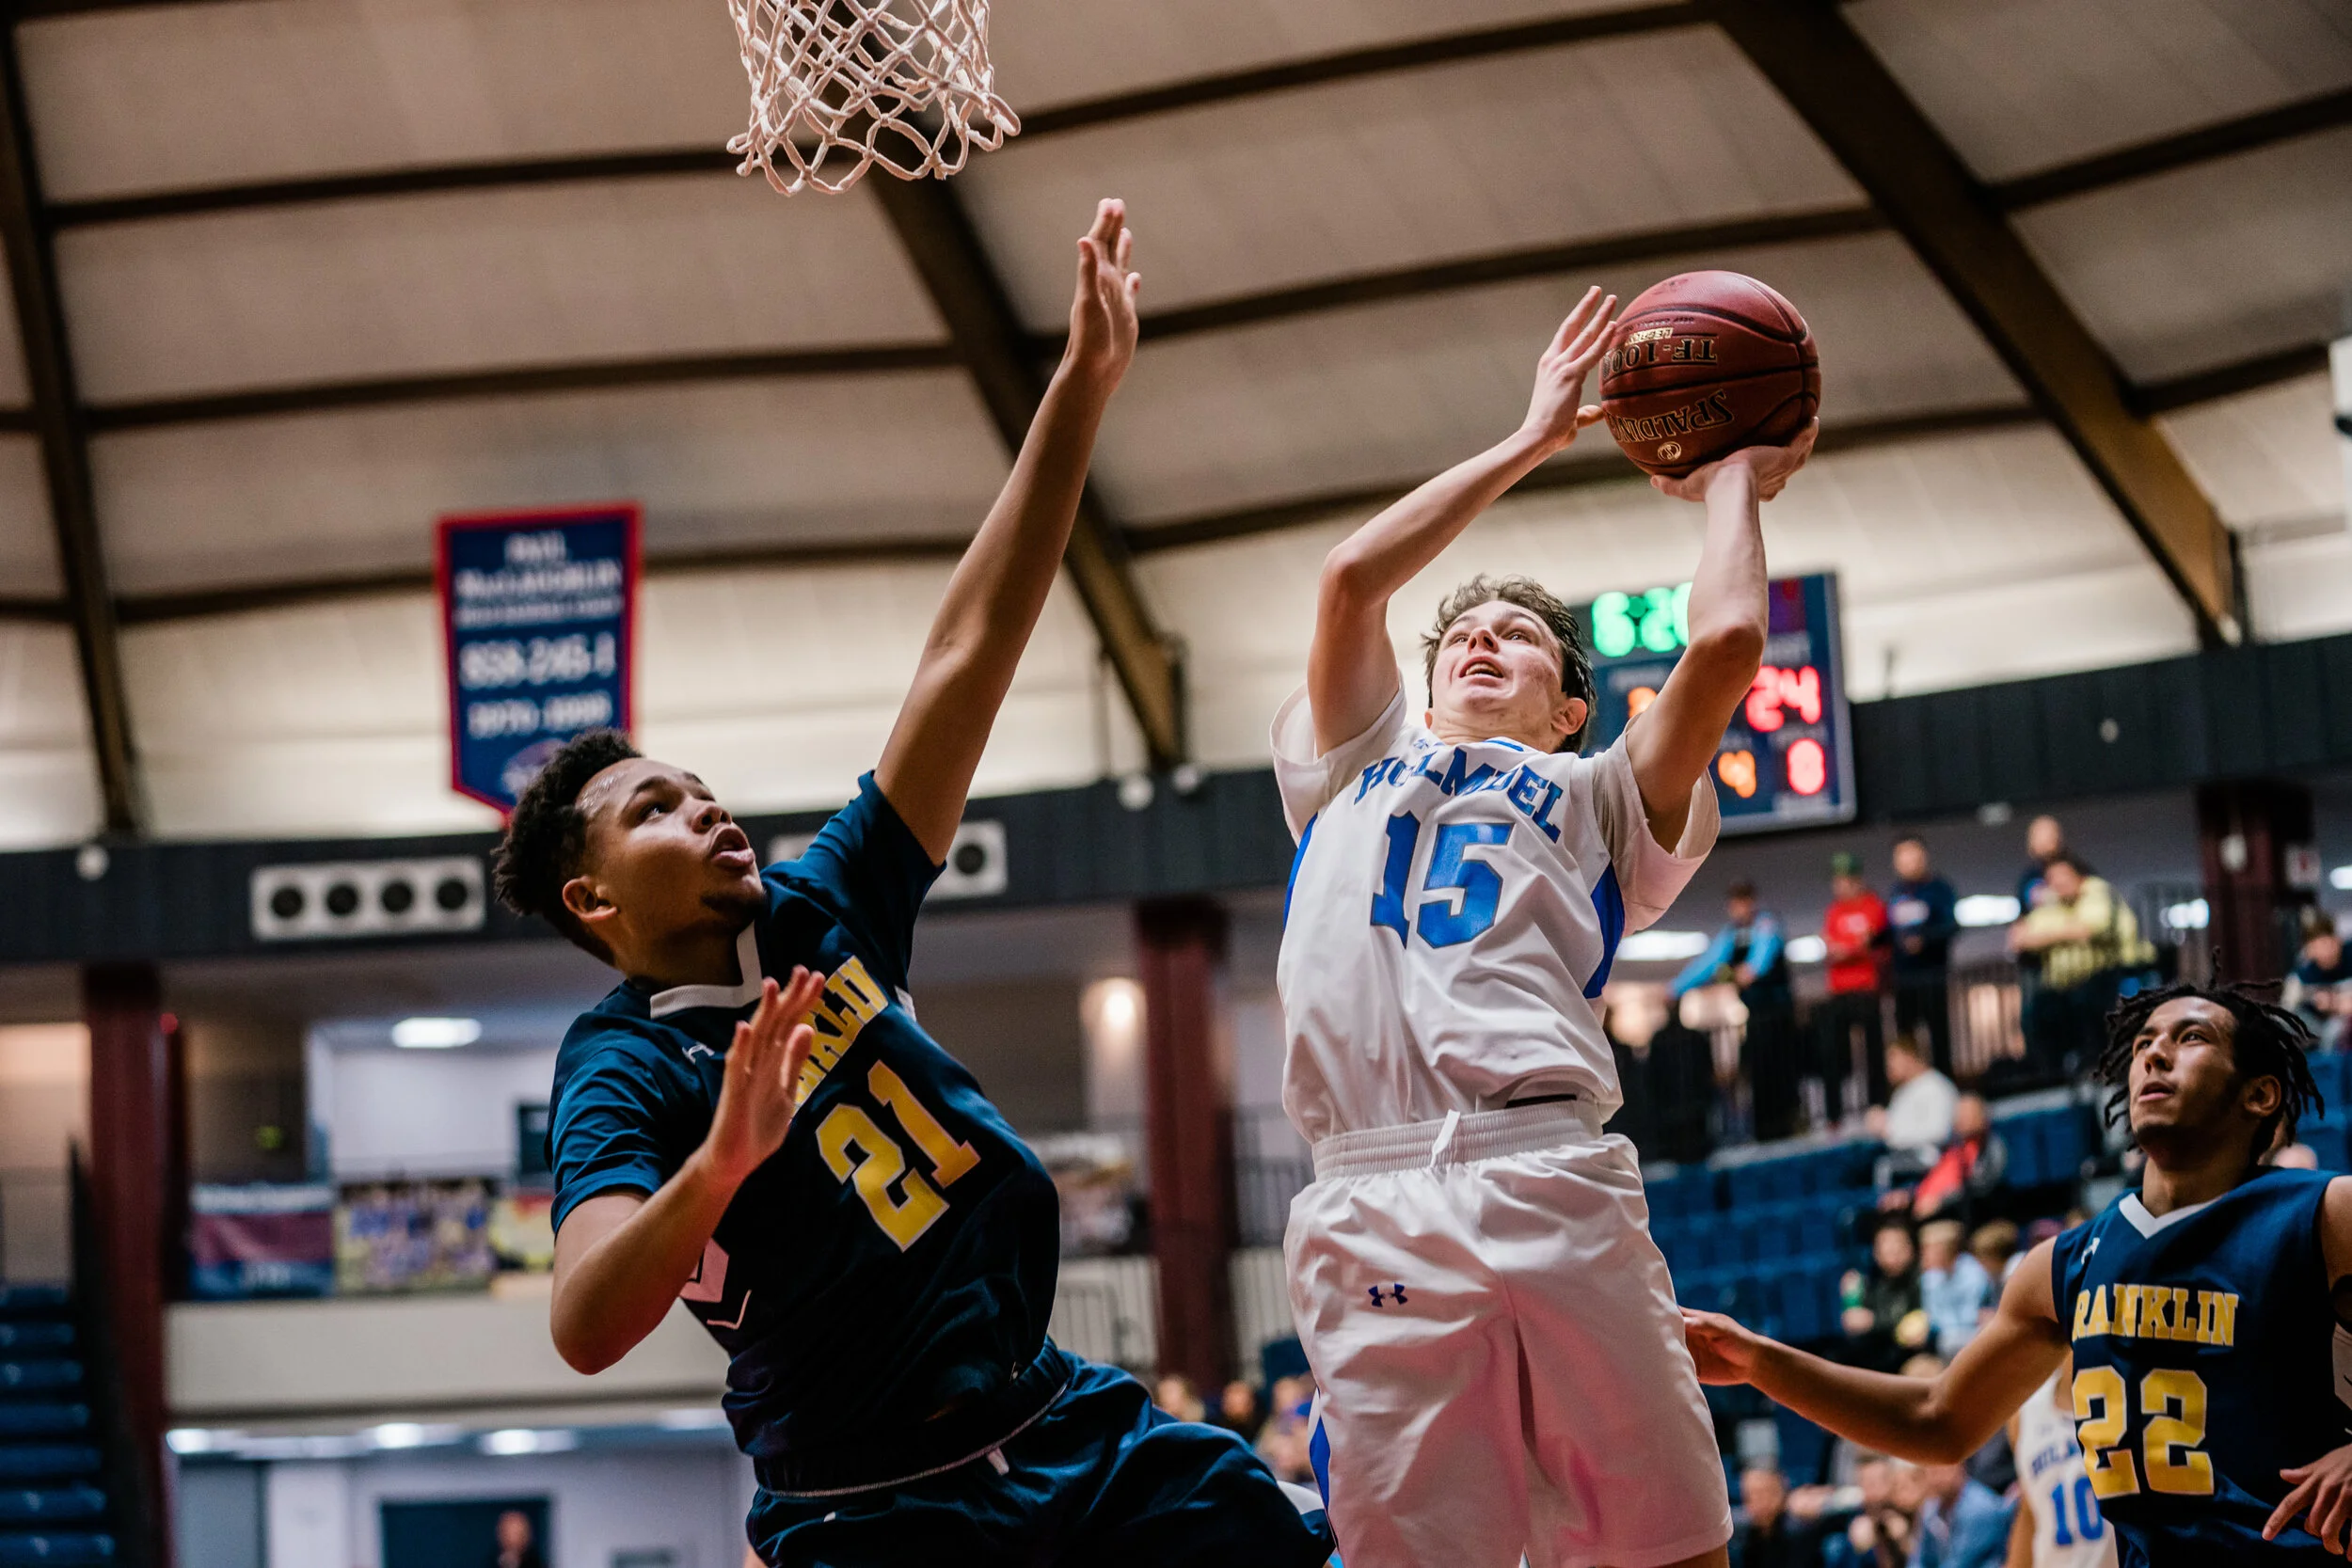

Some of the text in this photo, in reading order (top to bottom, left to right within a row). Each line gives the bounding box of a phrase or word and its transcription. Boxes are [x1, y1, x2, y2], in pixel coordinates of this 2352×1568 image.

[1747, 666, 1821, 732] 24
[1354, 747, 1564, 844] HOLMDEL
[1370, 810, 1516, 950] 15
[816, 1059, 982, 1252] 21
[2072, 1283, 2239, 1347] RANKLIN
[2072, 1365, 2215, 1499] 22
[2052, 1475, 2105, 1545] 10
